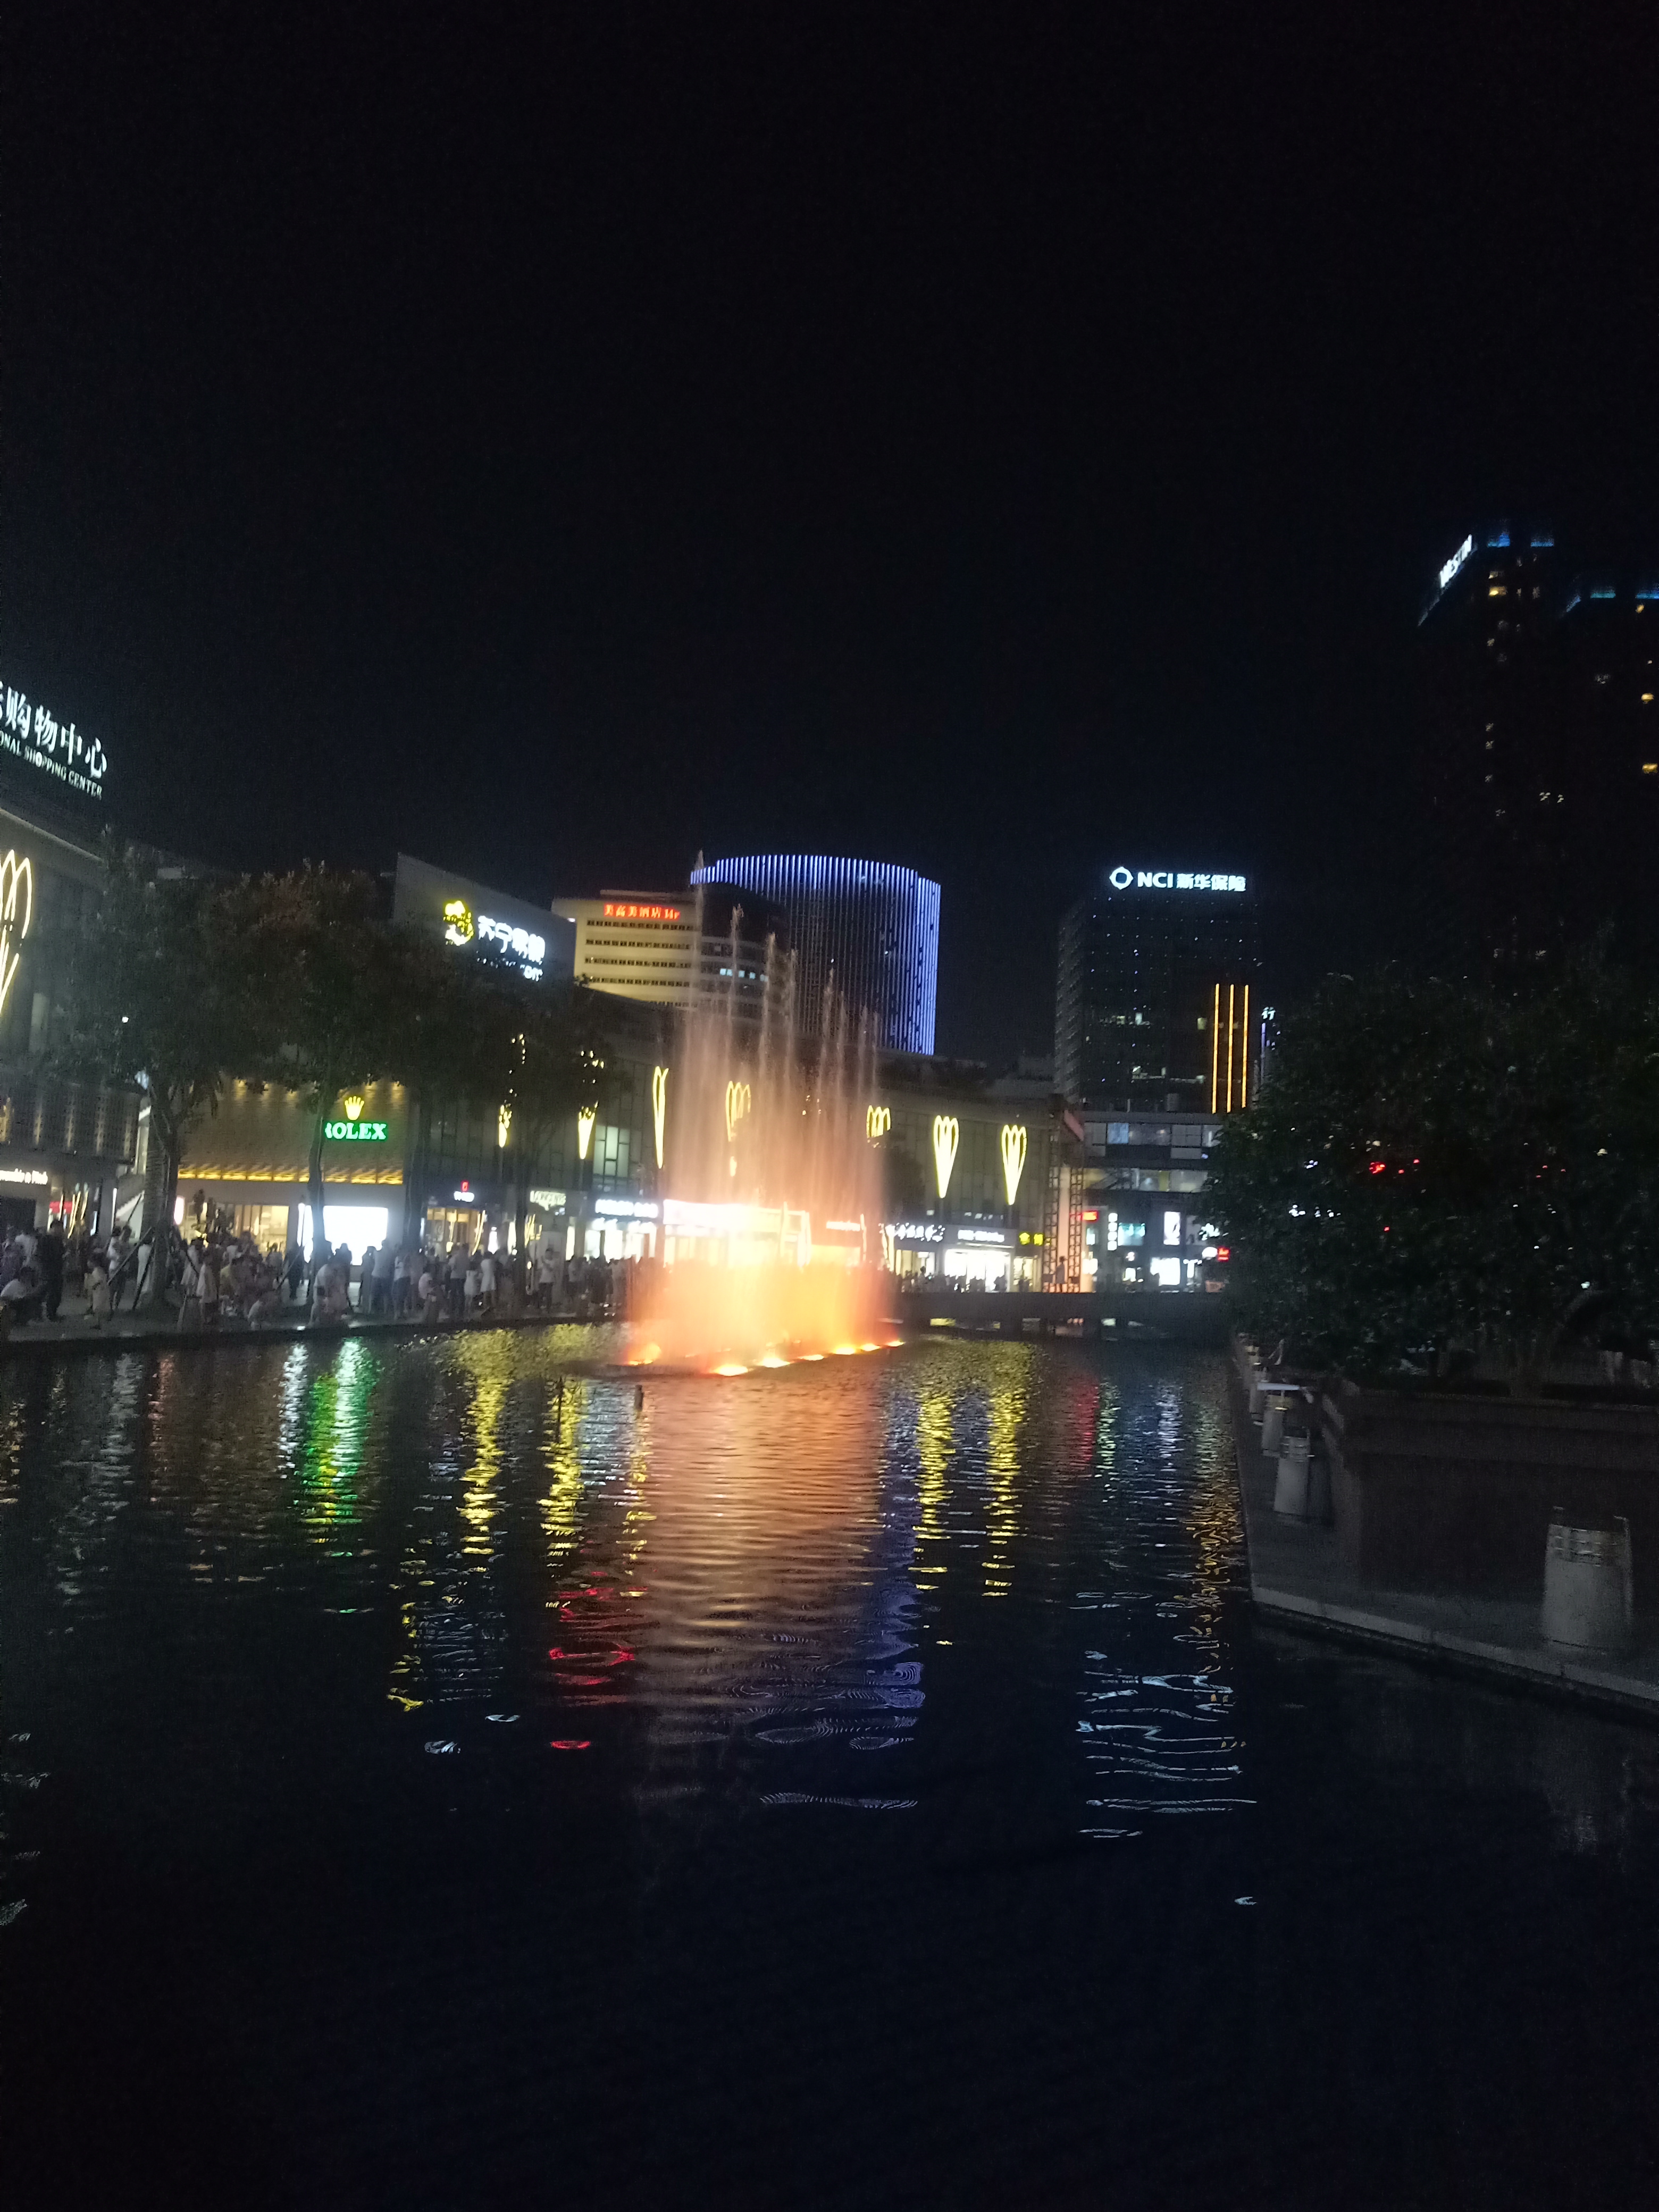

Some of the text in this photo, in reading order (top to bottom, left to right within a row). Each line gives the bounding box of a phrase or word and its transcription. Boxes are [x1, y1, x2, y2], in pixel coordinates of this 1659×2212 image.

[0, 681, 107, 778] 购物中心
[23, 745, 66, 781] SHOPPING
[69, 770, 102, 800] CENTER
[1137, 872, 1246, 892] NCI 新华保险
